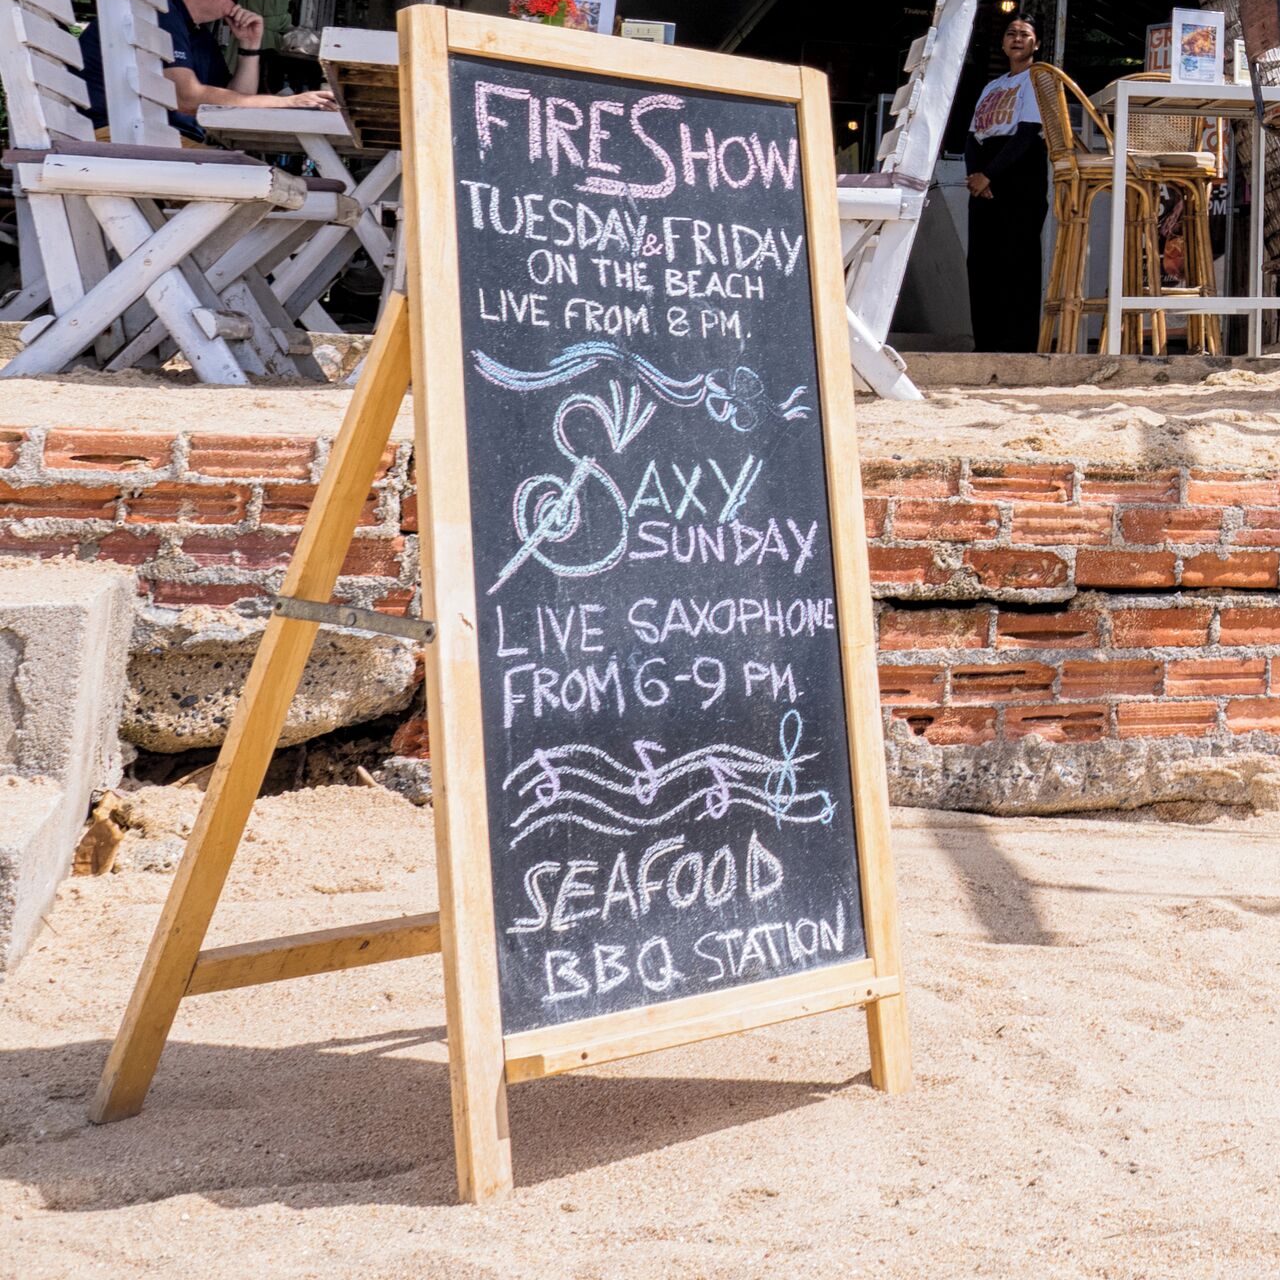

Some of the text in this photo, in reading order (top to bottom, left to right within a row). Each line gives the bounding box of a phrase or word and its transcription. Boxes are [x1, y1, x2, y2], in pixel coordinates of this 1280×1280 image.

[473, 80, 798, 199] FIRE SHOW
[461, 180, 803, 276] TUESDAY & FRIDAY
[478, 287, 550, 327] LIVE
[564, 298, 650, 338] FROM
[667, 307, 690, 339] 8
[526, 249, 764, 302] ON THE BEACH
[628, 518, 818, 574] SUNDAY
[496, 596, 836, 657] LIVE SAXOPHONE
[503, 651, 626, 729] FROM
[634, 656, 727, 710] 6-9
[506, 828, 784, 934] SEAFOOD
[541, 899, 845, 1003] BBQ STATION
